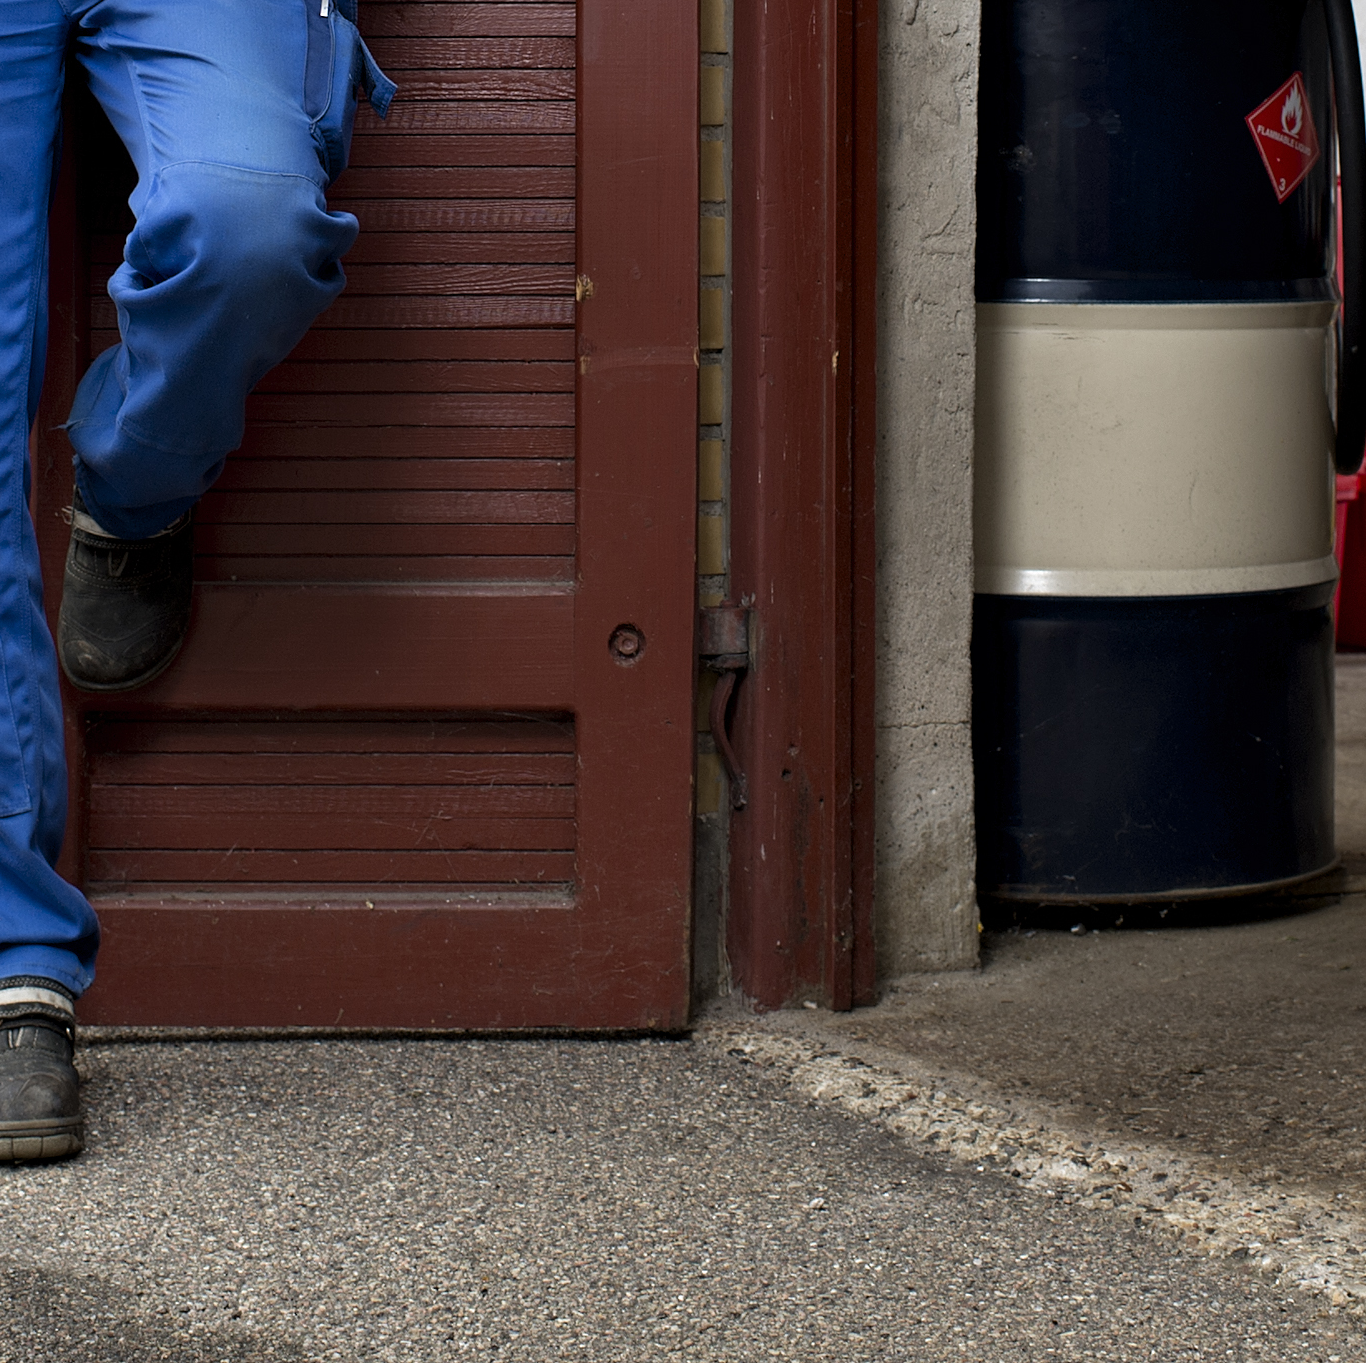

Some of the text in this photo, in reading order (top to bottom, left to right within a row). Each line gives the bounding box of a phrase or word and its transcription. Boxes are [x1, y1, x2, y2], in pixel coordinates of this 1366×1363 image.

[1257, 124, 1312, 156] FLAMMABLE LIQUID
[1278, 178, 1287, 192] 3
